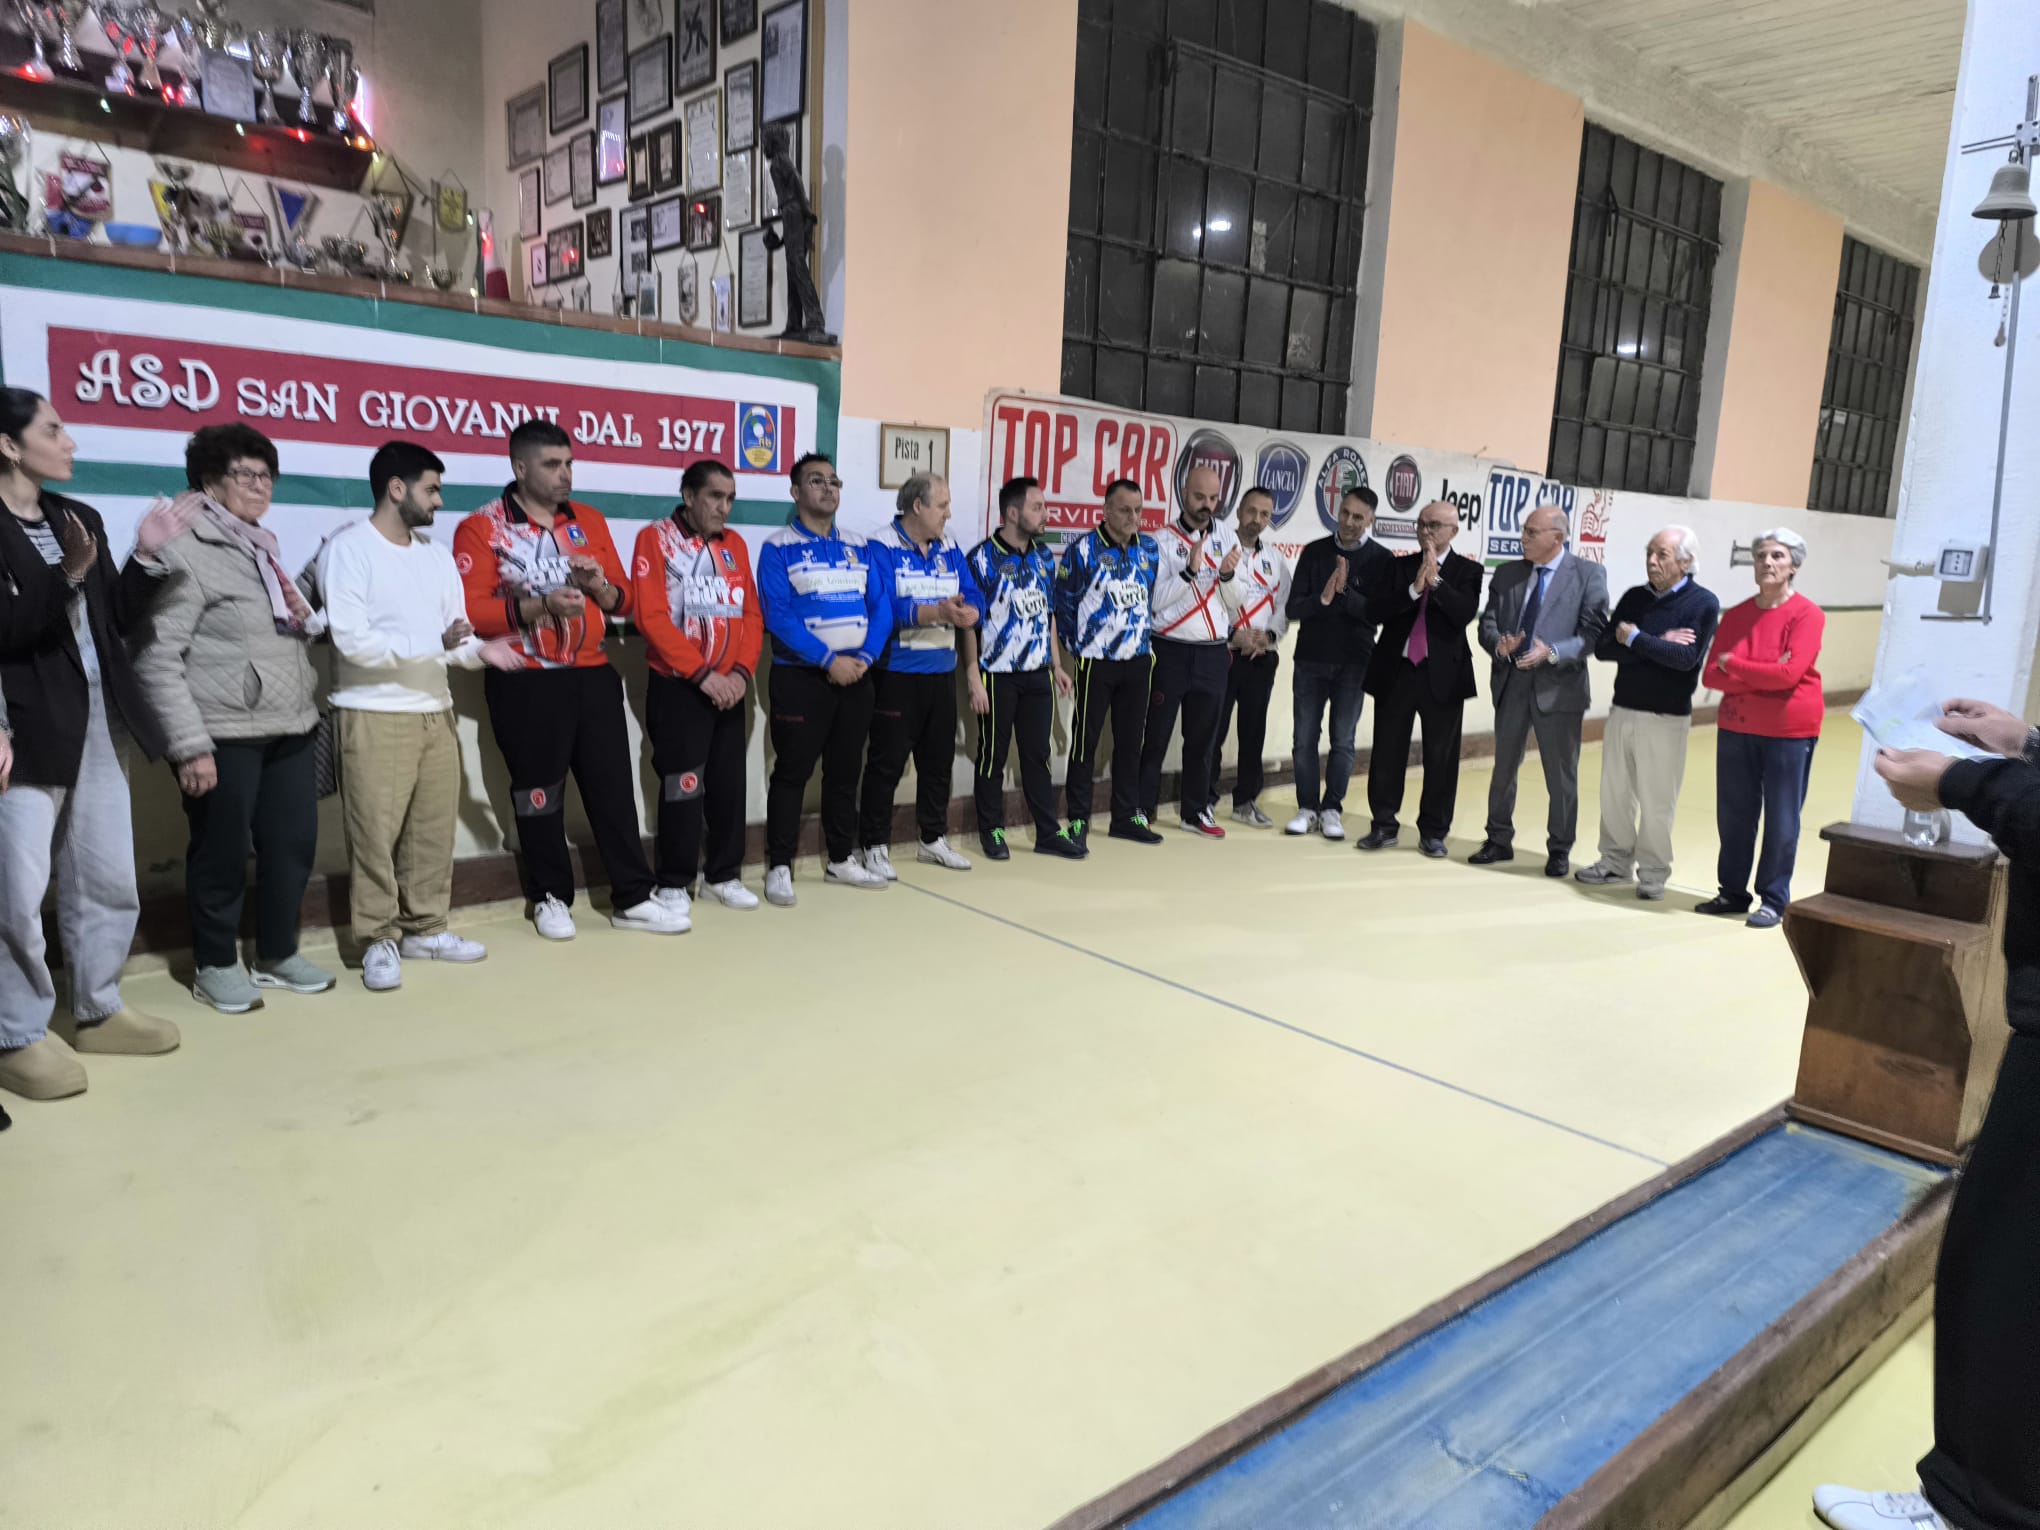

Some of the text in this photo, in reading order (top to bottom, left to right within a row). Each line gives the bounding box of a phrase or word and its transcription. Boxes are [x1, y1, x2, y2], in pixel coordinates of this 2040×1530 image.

[75, 349, 221, 412] ASD
[236, 376, 340, 423] SAN
[573, 409, 643, 448] DAL
[657, 416, 726, 454] 1977
[895, 436, 920, 461] Pista
[998, 405, 1079, 494] TOP
[1093, 418, 1172, 503] CAR
[1264, 468, 1295, 492] LANCIA
[1318, 452, 1339, 489] ALFA
[1394, 471, 1415, 498] FIAT
[1046, 506, 1104, 525] RVIC
[1489, 473, 1530, 533] TOP
